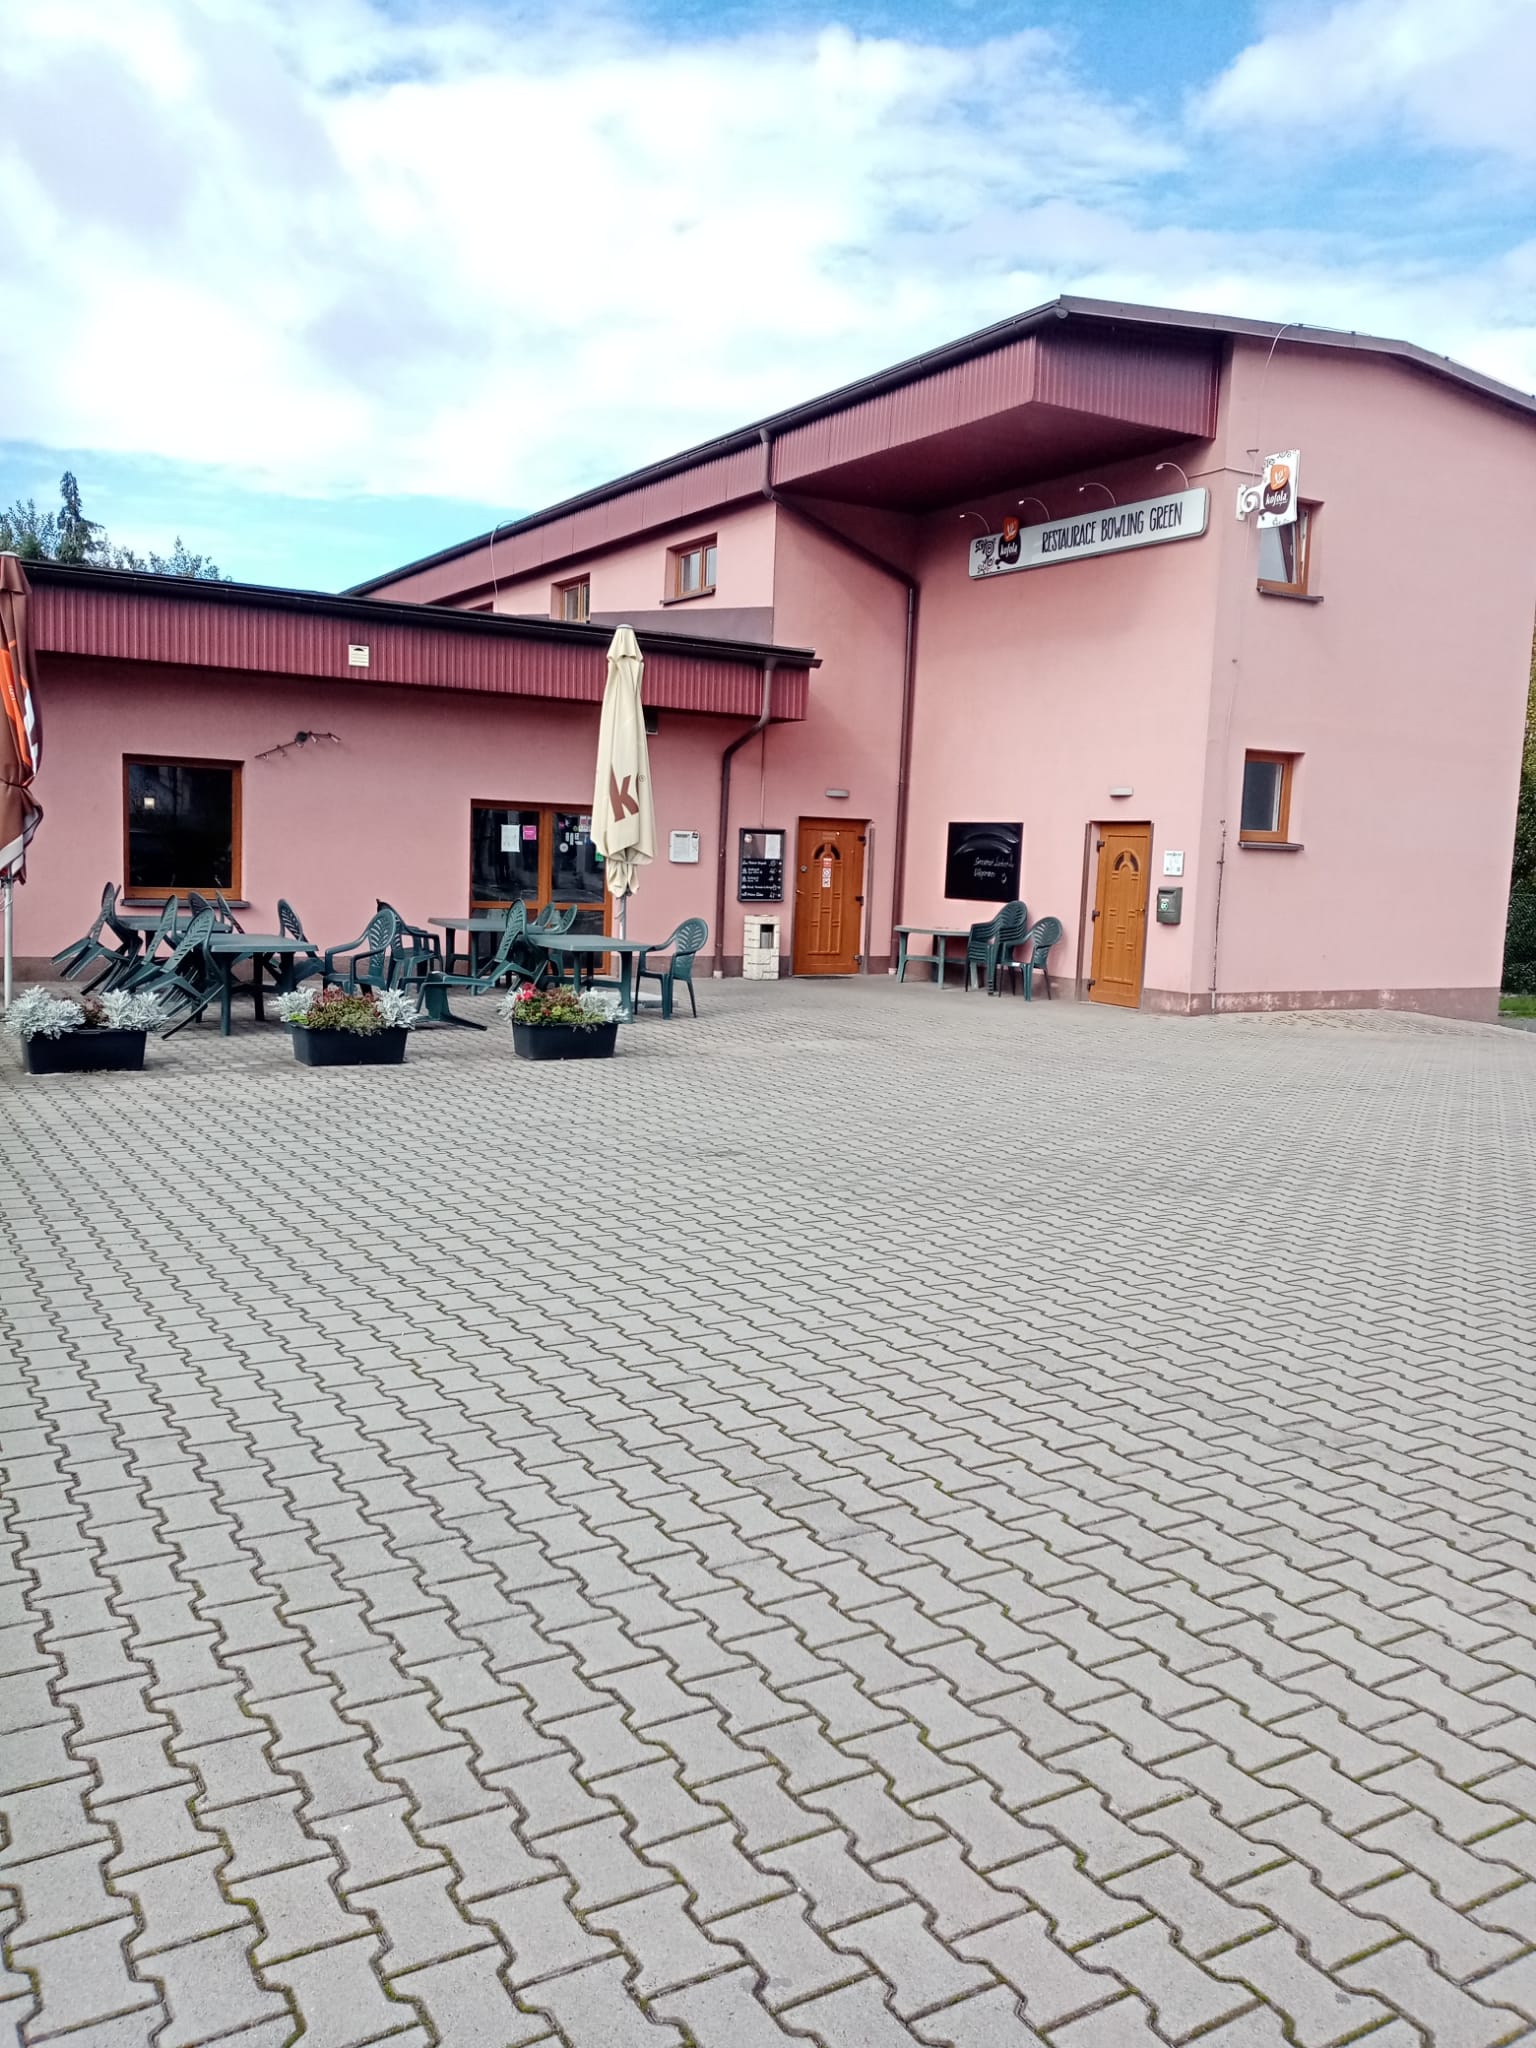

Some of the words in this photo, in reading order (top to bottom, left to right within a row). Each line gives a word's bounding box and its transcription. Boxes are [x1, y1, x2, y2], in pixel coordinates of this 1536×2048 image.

[1041, 521, 1097, 553] RESTAURACE
[1100, 510, 1145, 542] BOWLING
[1149, 501, 1183, 532] GREEN
